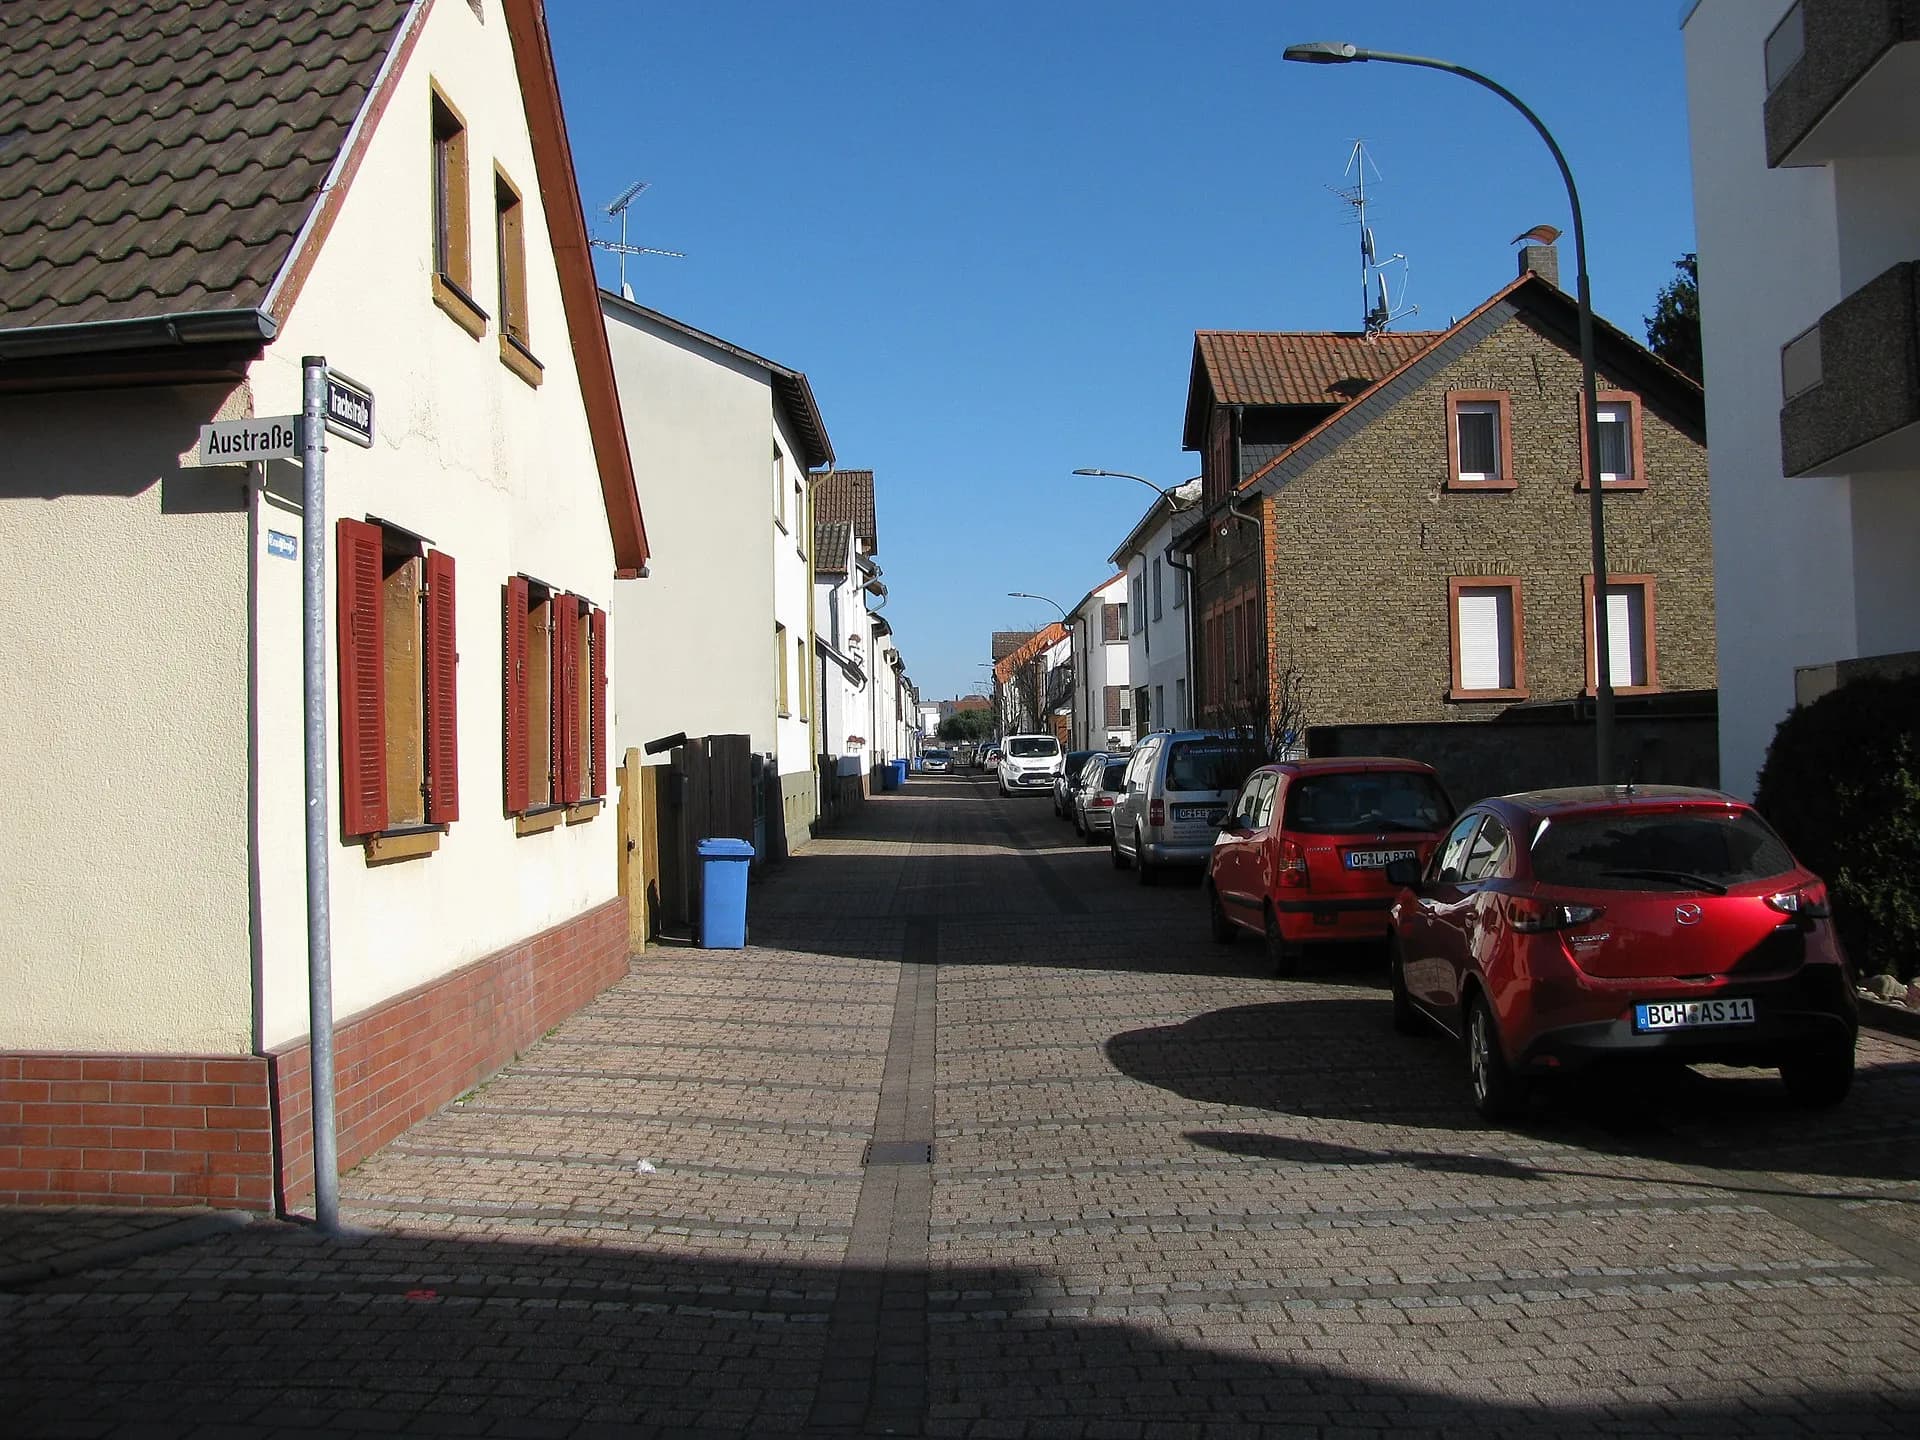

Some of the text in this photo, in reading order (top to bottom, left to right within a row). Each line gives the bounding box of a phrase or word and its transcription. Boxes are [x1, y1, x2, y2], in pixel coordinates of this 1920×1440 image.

[208, 424, 293, 455] Austraße
[1352, 853, 1367, 865] OF
[1375, 852, 1391, 864] LA
[1648, 1001, 1753, 1025] BCH AS 11
